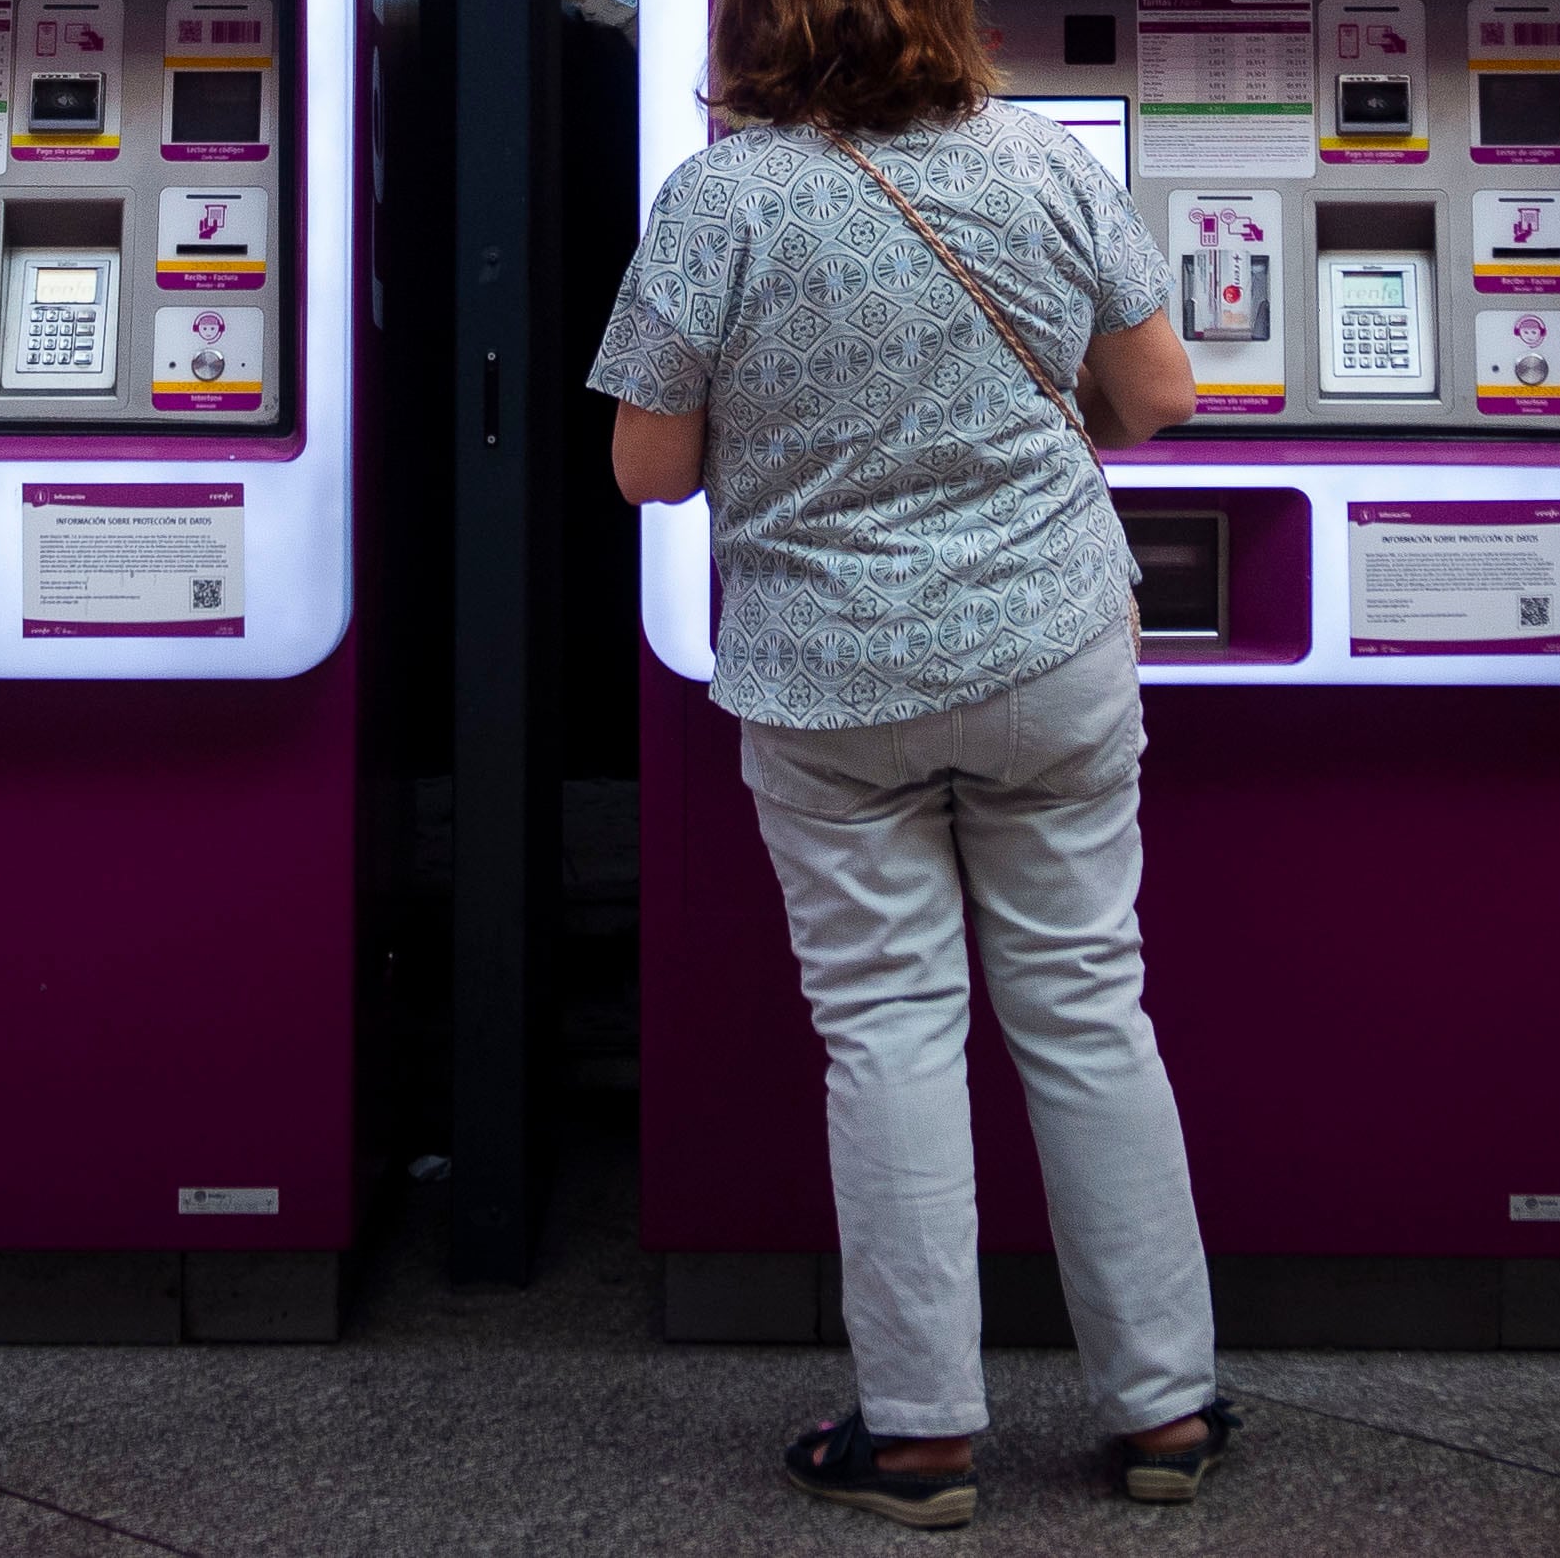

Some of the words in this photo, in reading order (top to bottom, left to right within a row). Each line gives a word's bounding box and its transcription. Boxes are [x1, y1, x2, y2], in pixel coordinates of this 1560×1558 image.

[187, 146, 206, 154] Lector
[208, 146, 217, 154] de
[219, 146, 244, 155] códigos
[184, 273, 207, 281] Recibo
[213, 273, 238, 281] Factura
[1347, 283, 1399, 301] renfe
[56, 516, 106, 525] INFORMACIÓN
[108, 517, 130, 525] SOBRE
[132, 516, 176, 525] PROTECCIÓN
[178, 517, 187, 525] DE
[189, 517, 212, 525] DATOS
[1459, 534, 1503, 543] PROTECCIÓN
[1504, 535, 1514, 543] DE
